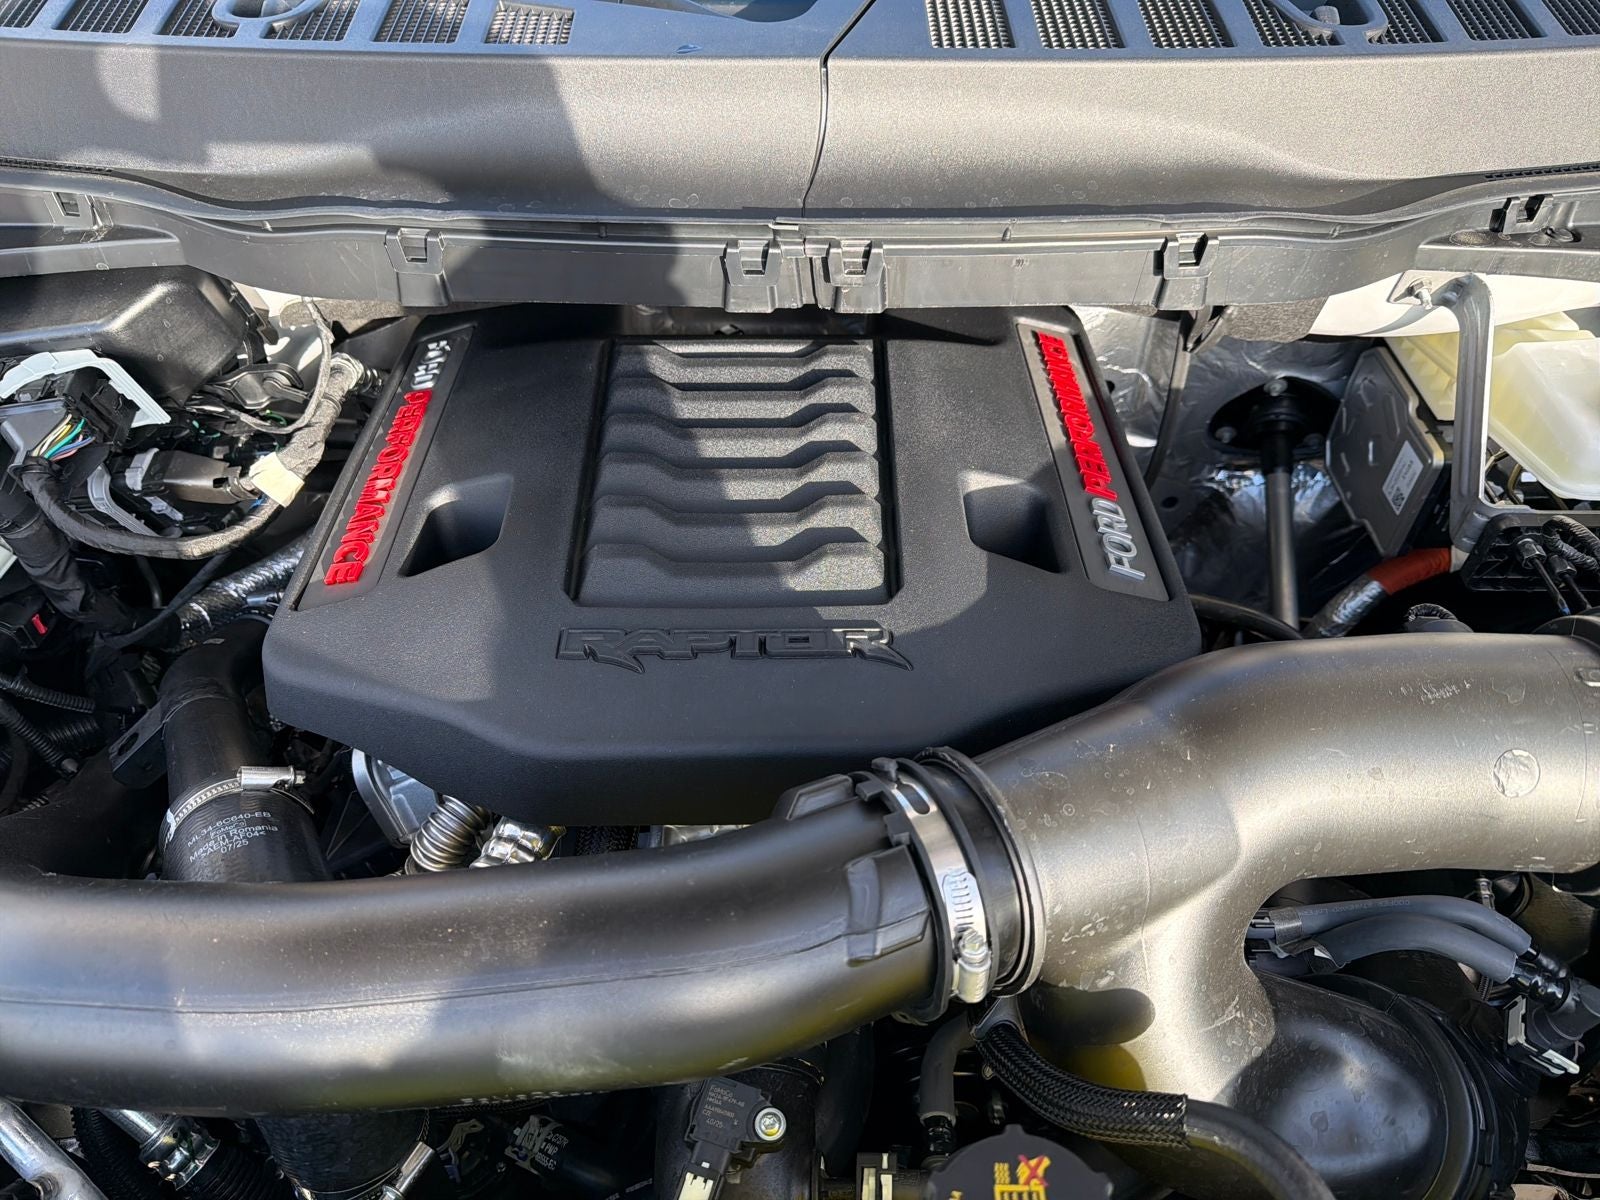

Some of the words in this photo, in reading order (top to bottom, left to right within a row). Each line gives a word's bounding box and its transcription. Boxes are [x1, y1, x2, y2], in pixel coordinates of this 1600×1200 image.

[1037, 331, 1118, 501] PERFORMANCE
[323, 389, 433, 586] PERFORMANCE
[1091, 497, 1146, 581] FORD
[556, 628, 914, 674] RAPTOR
[189, 839, 215, 862] Made
[217, 833, 227, 842] in
[229, 824, 279, 837] Romania
[220, 839, 249, 853] 07/25
